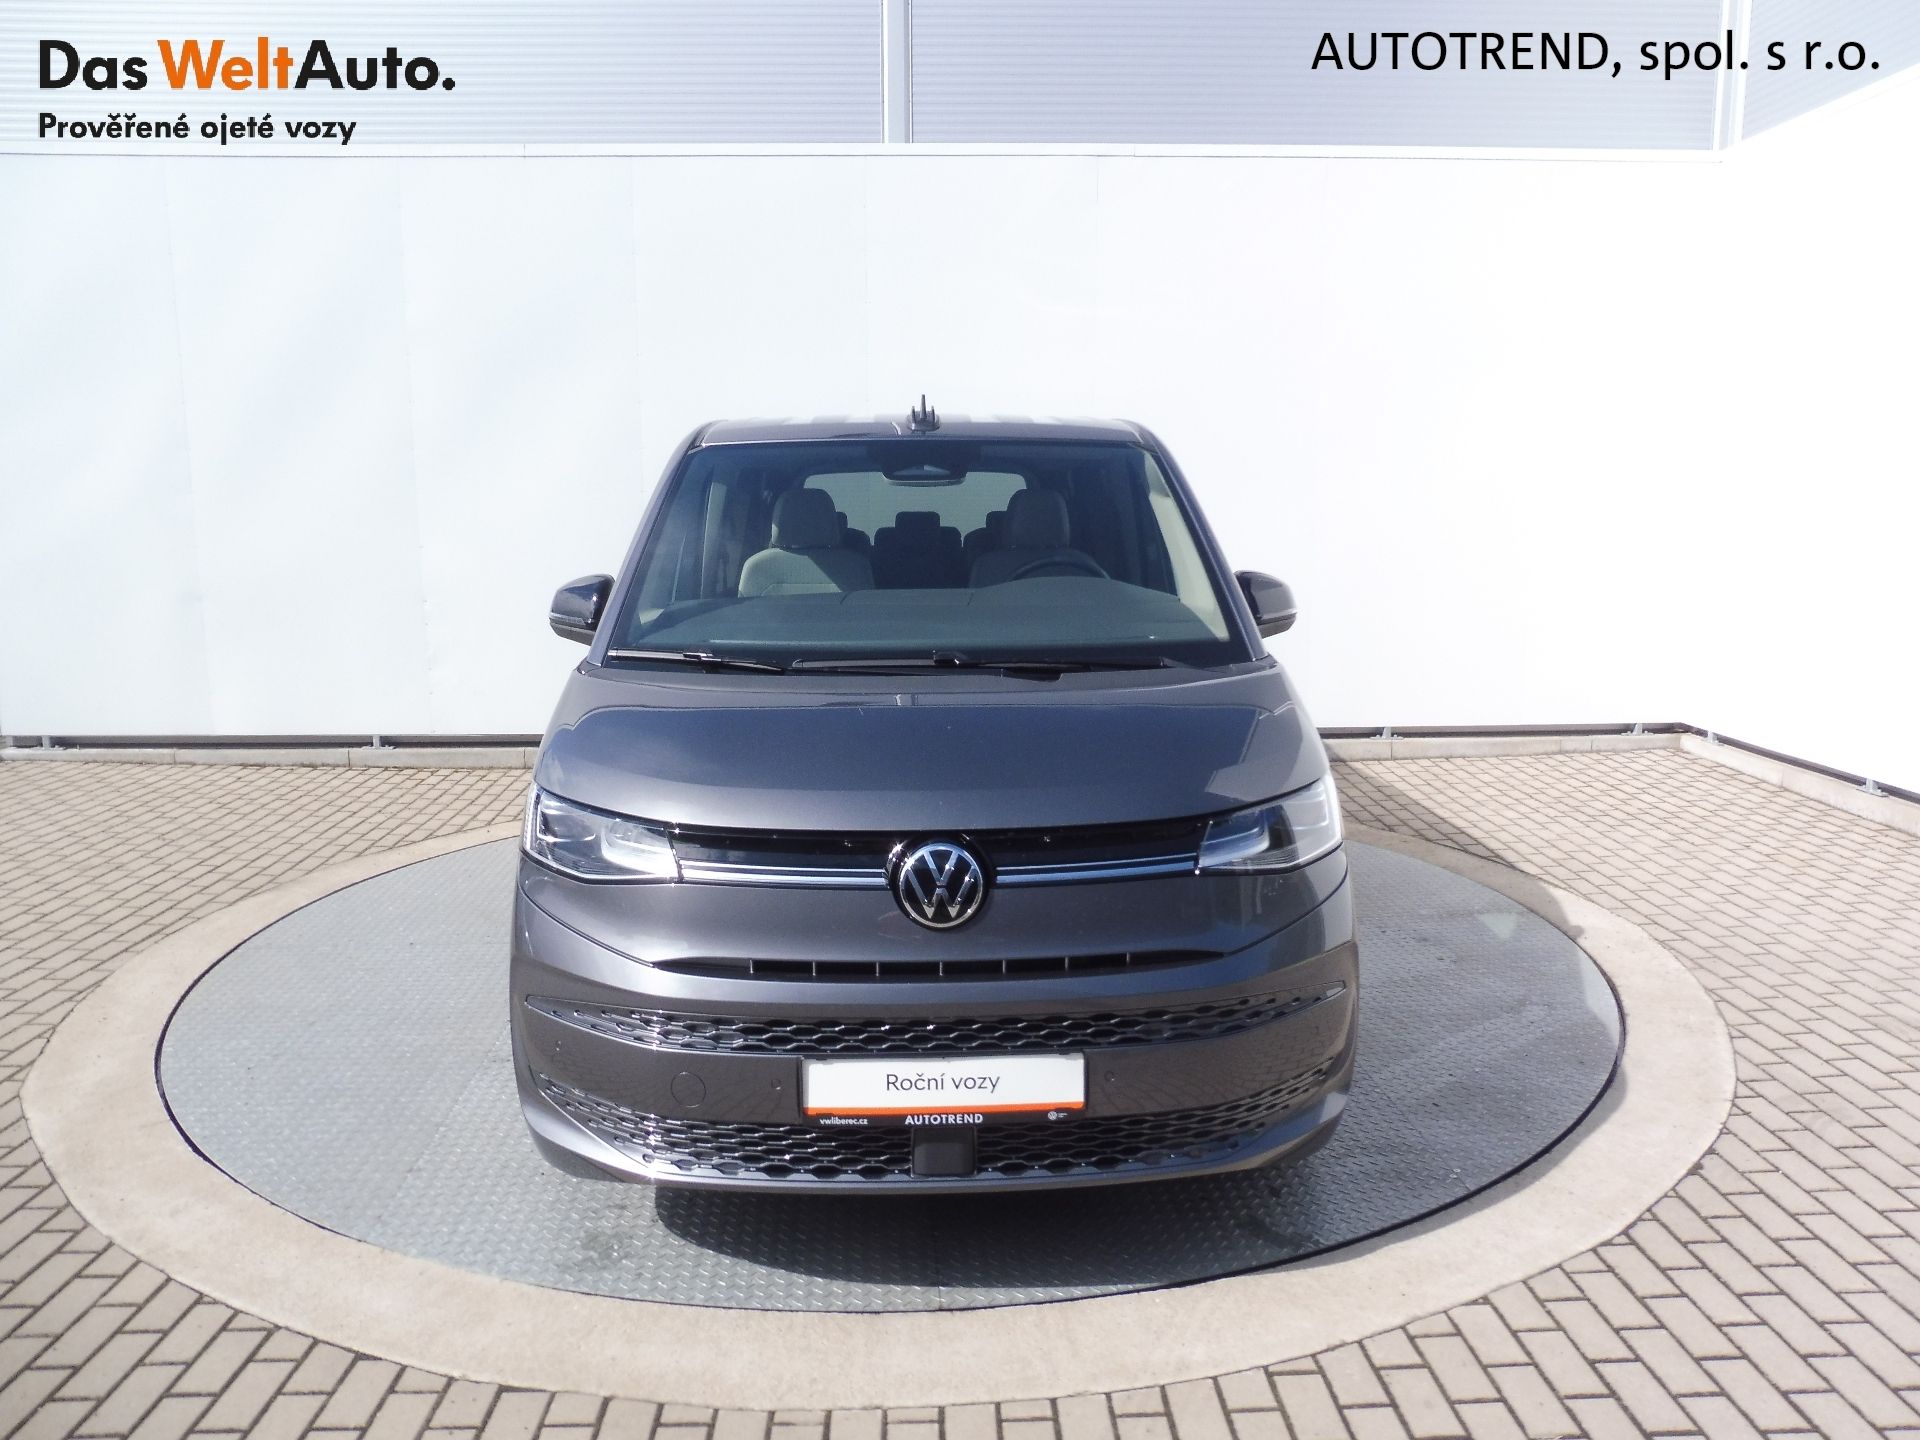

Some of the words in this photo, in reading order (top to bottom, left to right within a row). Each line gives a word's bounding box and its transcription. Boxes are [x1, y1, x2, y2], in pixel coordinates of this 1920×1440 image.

[886, 1072, 945, 1092] Roční
[951, 1075, 1000, 1093] vozy
[820, 1116, 868, 1125] vwliberec.cz
[905, 1113, 984, 1125] AUTOTREND
